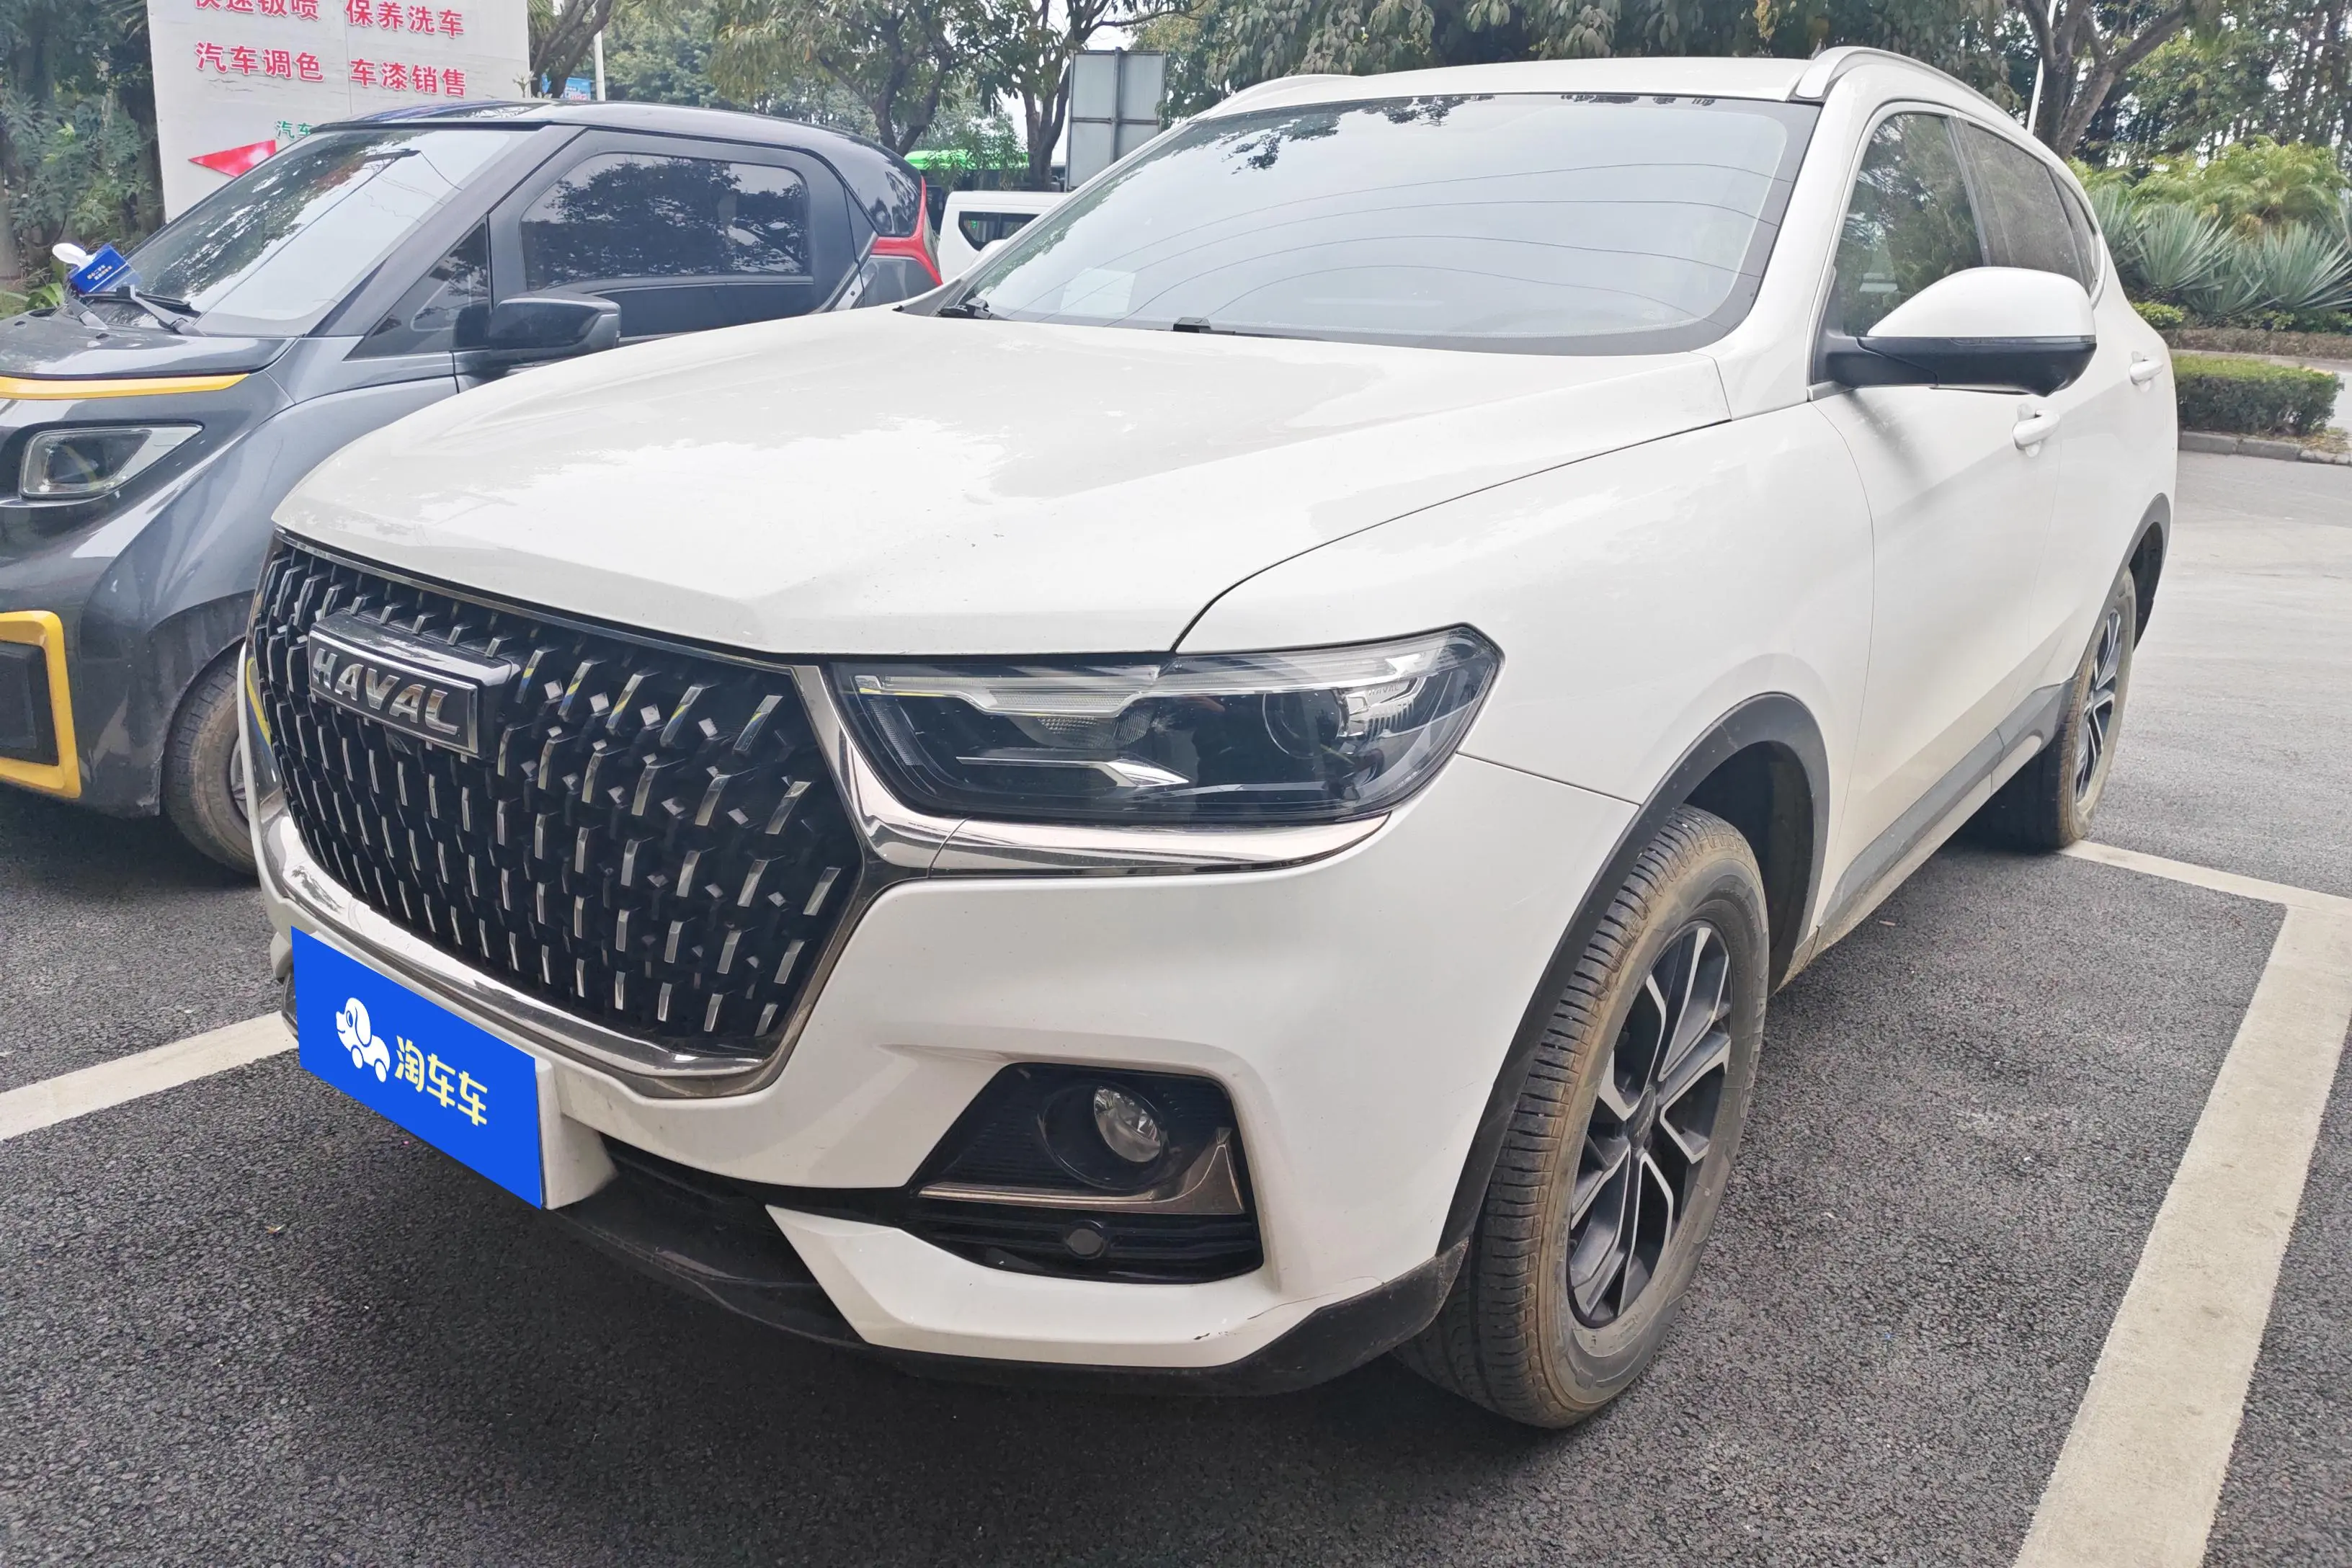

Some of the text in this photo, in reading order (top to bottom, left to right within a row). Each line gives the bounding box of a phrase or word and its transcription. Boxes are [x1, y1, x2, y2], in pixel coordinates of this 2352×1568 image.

[196, 0, 464, 37] 钣喷 保养洗车
[196, 41, 466, 96] 汽车调色 车漆销售
[312, 648, 460, 736] HAVAL
